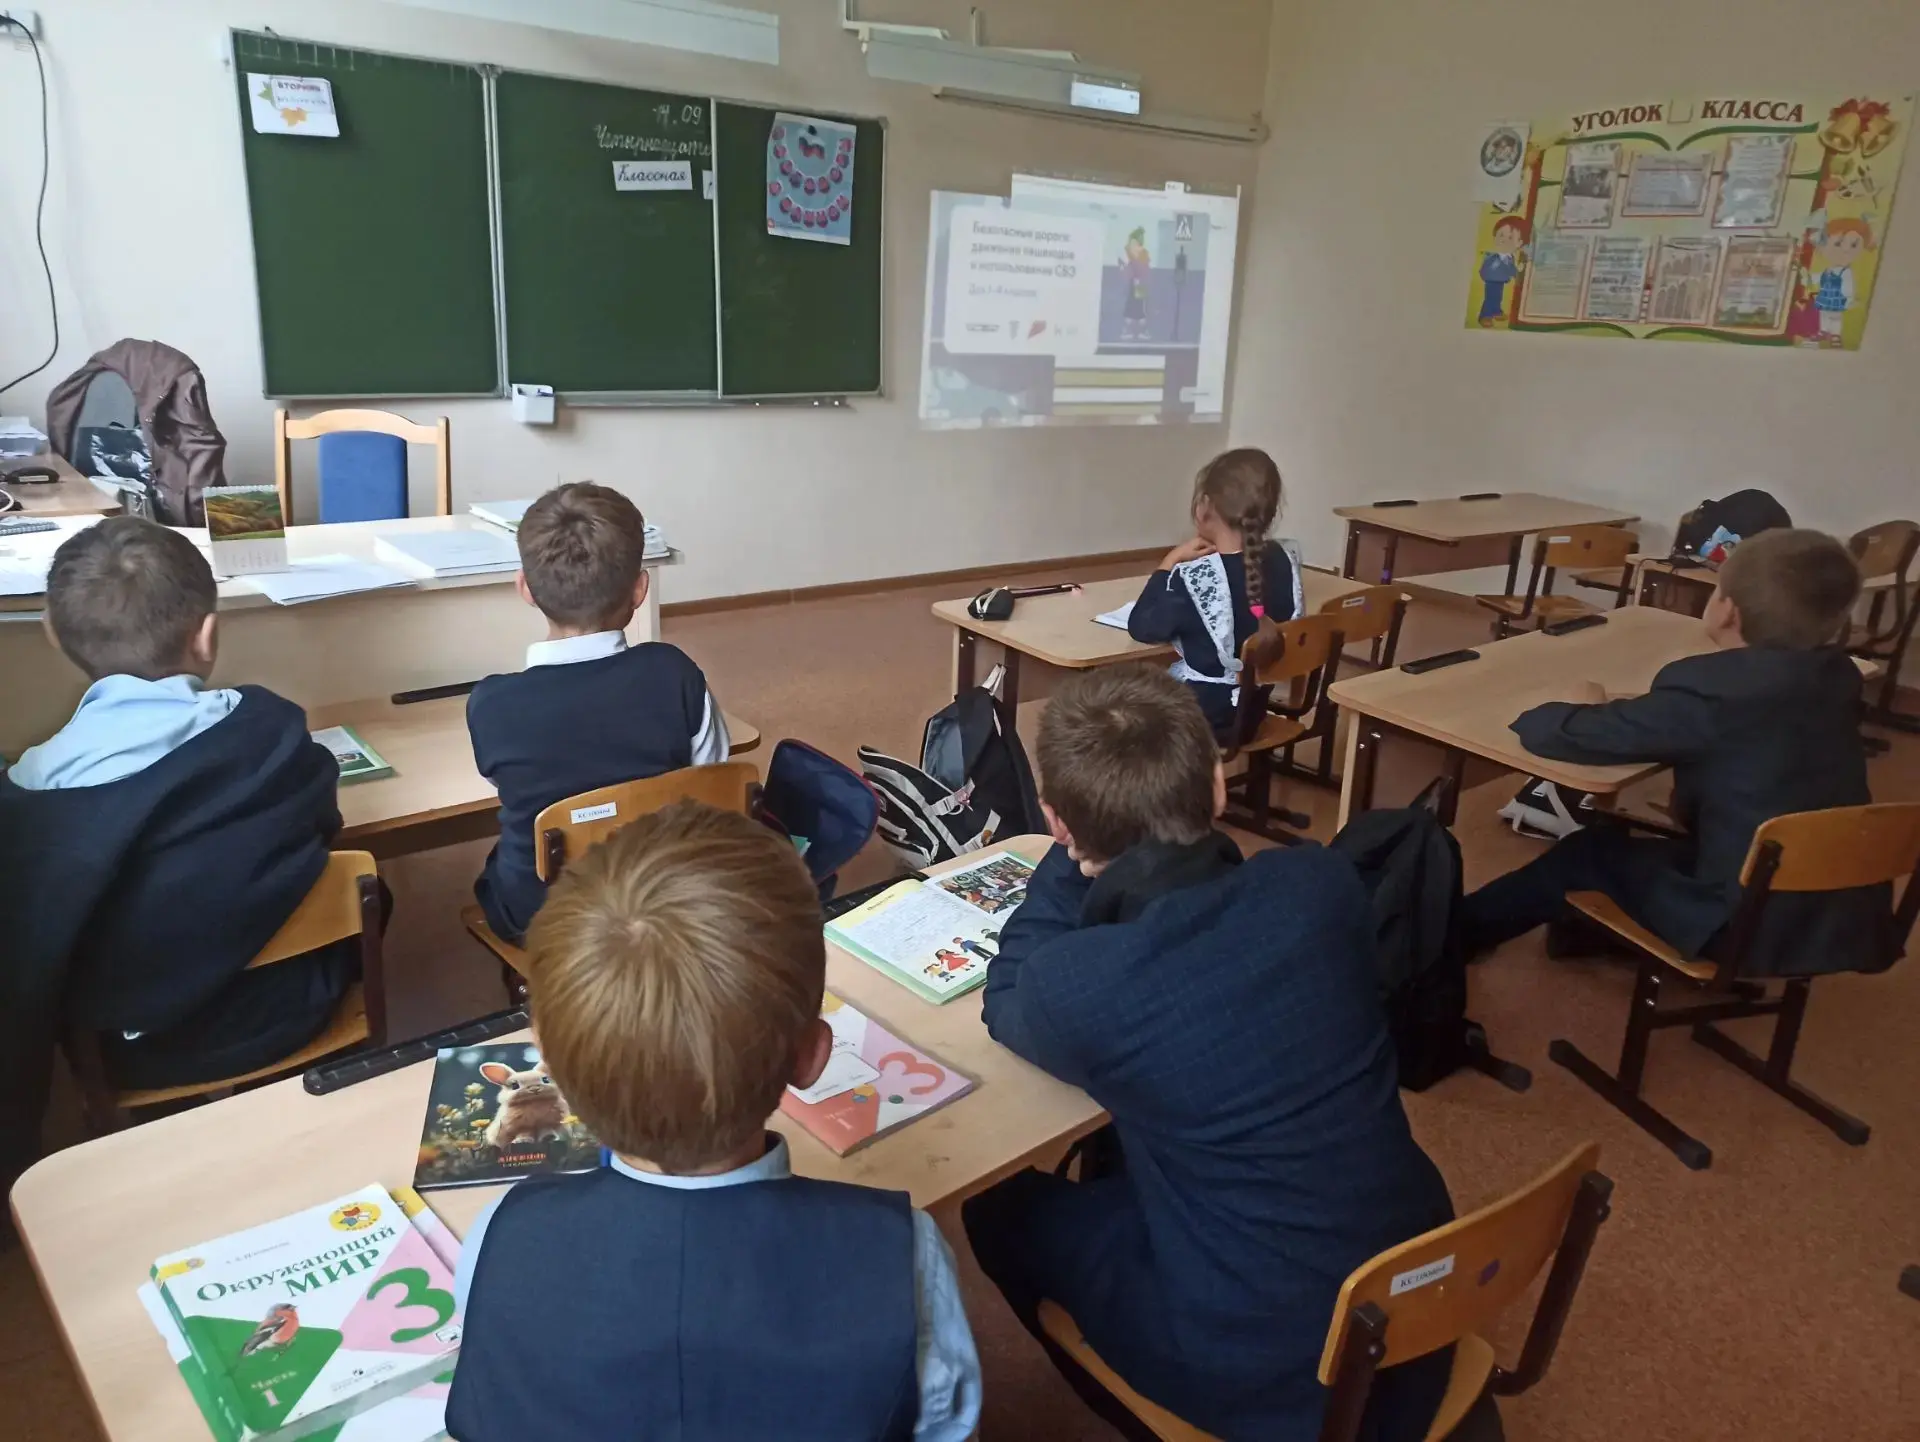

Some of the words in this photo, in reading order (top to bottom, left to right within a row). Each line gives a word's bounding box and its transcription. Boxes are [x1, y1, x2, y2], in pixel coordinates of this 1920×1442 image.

[1572, 103, 1664, 133] УГОЛОК
[1700, 99, 1804, 123] КЛАССА
[618, 163, 687, 182] Классная
[878, 1051, 946, 1095] 3
[196, 1224, 397, 1301] Окружающий
[283, 1248, 380, 1297] МИР
[366, 1267, 456, 1343] 3
[263, 1387, 281, 1408] 1
